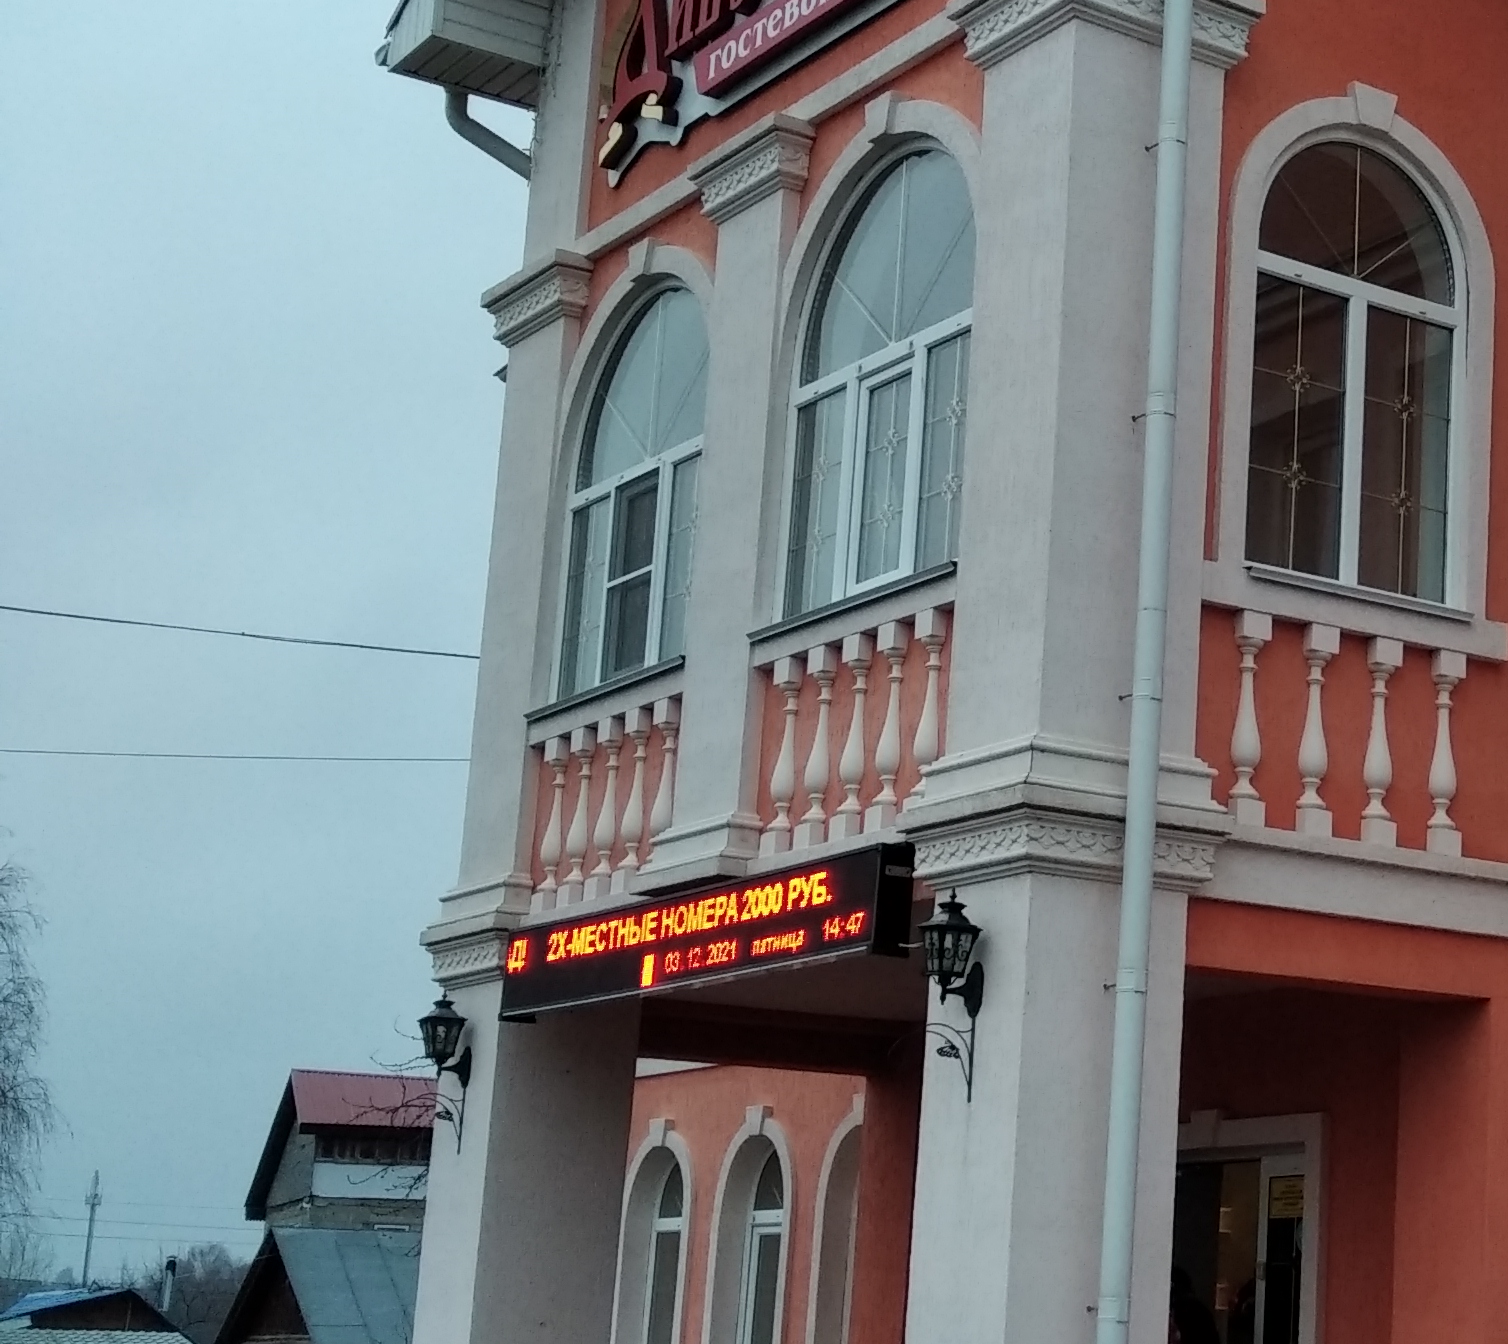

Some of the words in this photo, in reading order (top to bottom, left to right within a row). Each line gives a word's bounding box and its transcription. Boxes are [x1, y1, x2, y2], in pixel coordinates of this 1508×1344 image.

[660, 891, 739, 939] НОМЕРА
[740, 882, 783, 922] 2000
[786, 870, 832, 912] РУБ.
[664, 938, 737, 975] 03.12.2021
[751, 929, 807, 956] пятница
[822, 911, 866, 942] 14:47
